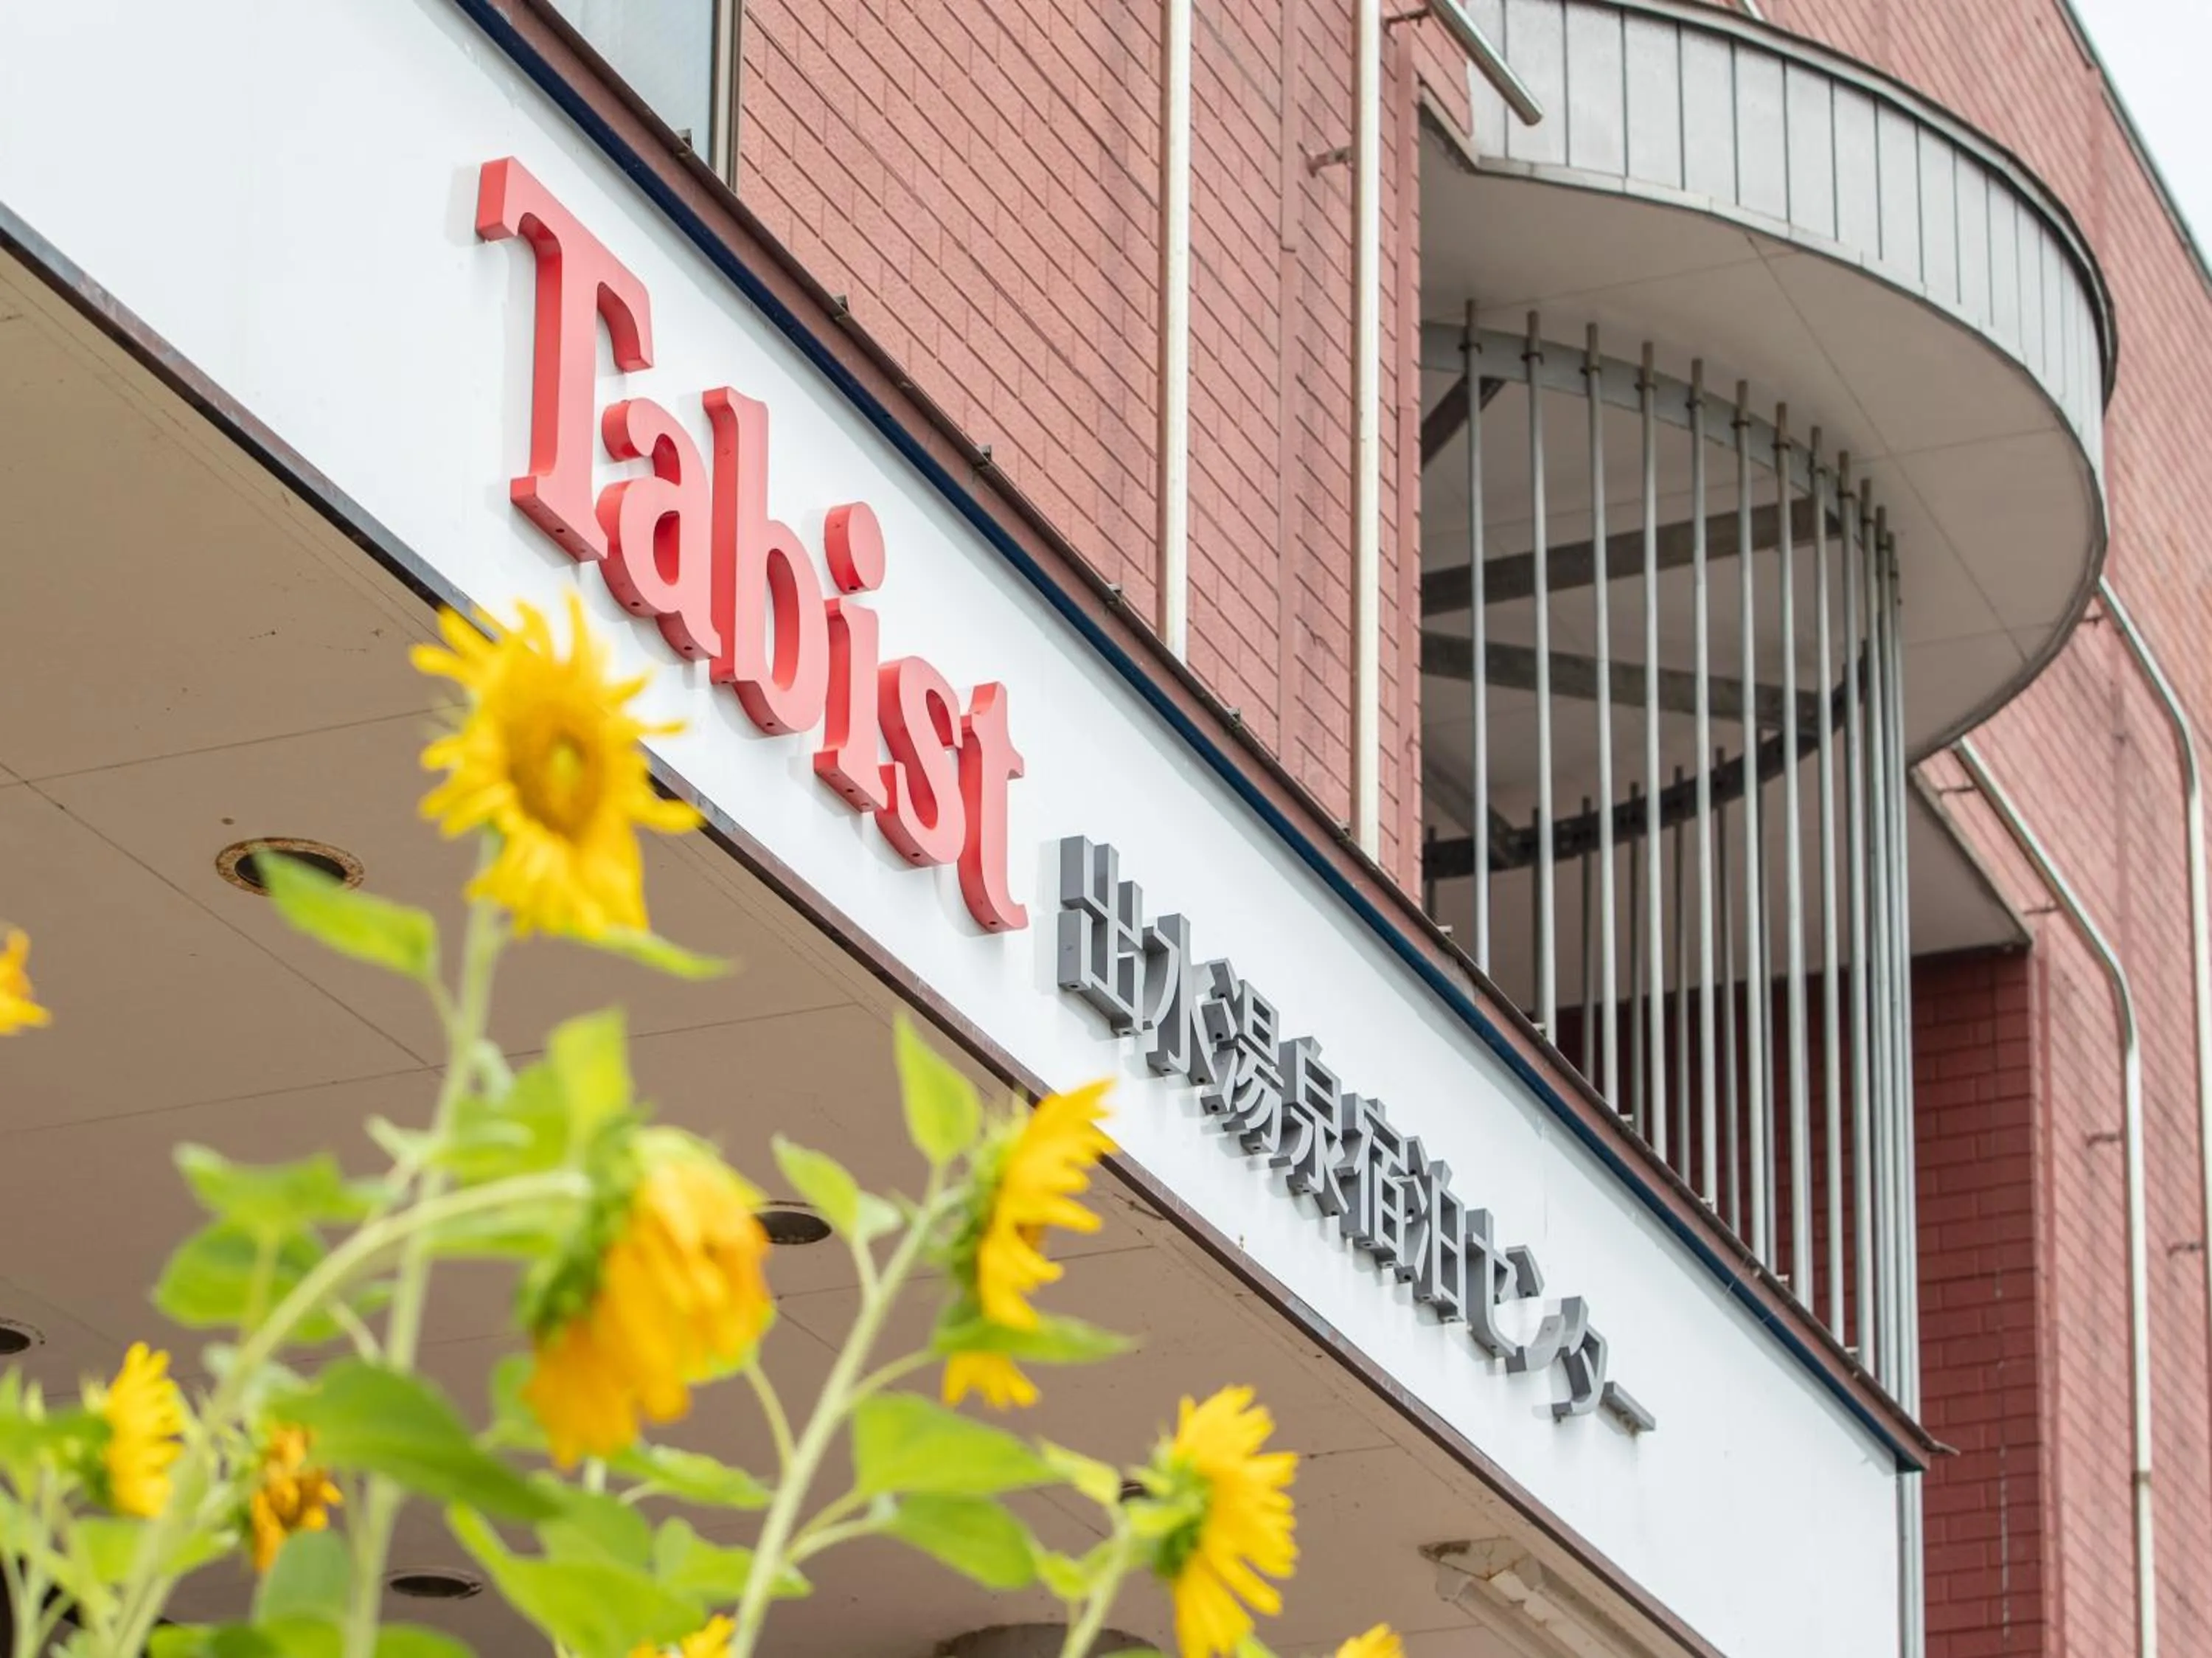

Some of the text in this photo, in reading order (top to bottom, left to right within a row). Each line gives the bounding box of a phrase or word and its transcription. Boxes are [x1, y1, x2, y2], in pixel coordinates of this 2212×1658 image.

[476, 156, 1028, 933] Tabist
[1058, 835, 1656, 1432] 出水湯泉宿泊センター
